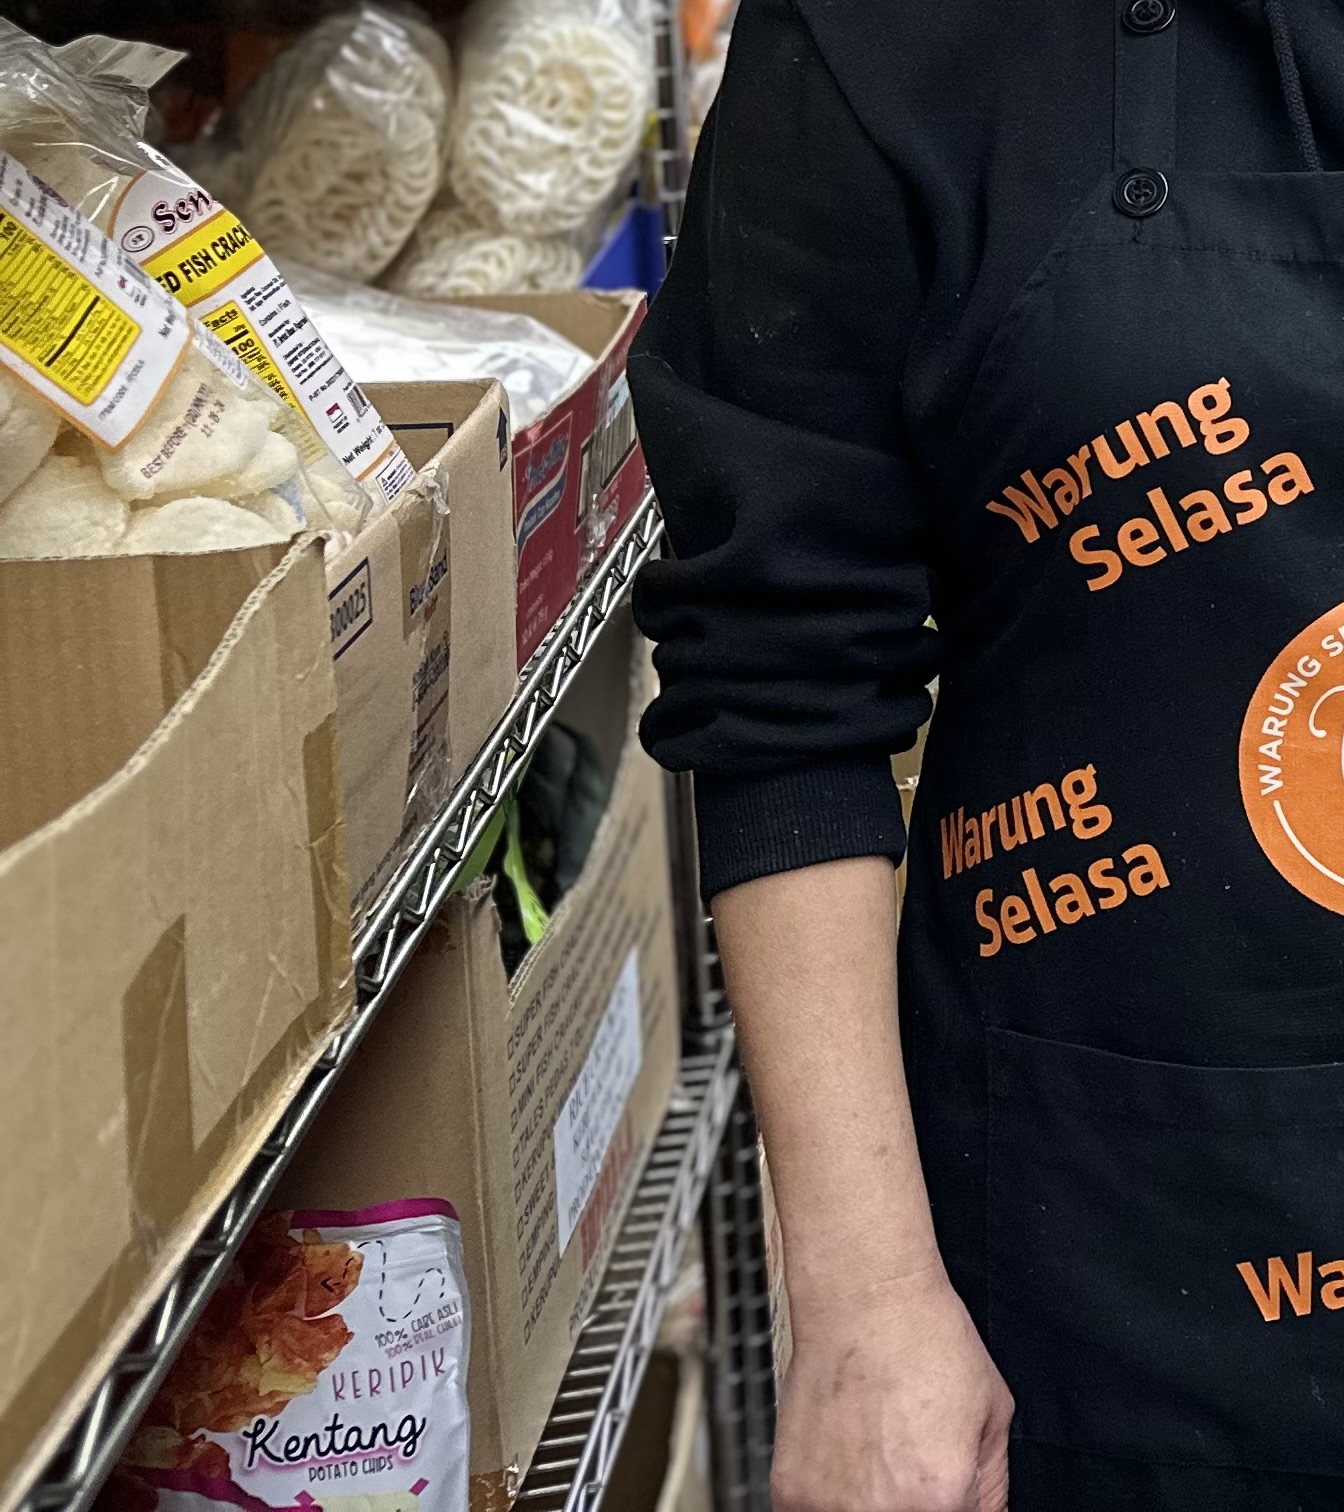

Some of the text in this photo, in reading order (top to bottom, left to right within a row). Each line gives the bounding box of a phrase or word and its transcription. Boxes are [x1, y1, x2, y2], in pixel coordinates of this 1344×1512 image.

[178, 248, 217, 283] FISH
[231, 338, 256, 356] 100
[140, 455, 164, 479] BEST
[986, 376, 1250, 545] Warung
[1068, 447, 1316, 593] Selasa
[1257, 654, 1322, 796] WARUNG
[940, 763, 1113, 880] Warung
[975, 843, 1170, 957] Selasa
[515, 990, 542, 1048] SUPER
[516, 1025, 543, 1083] SUPER
[524, 1161, 550, 1226] SWEET
[374, 1327, 408, 1349] 100%
[331, 1348, 447, 1402] KERIPIK
[243, 1412, 428, 1469] Kentang
[308, 1454, 394, 1483] POTATO CHIPS
